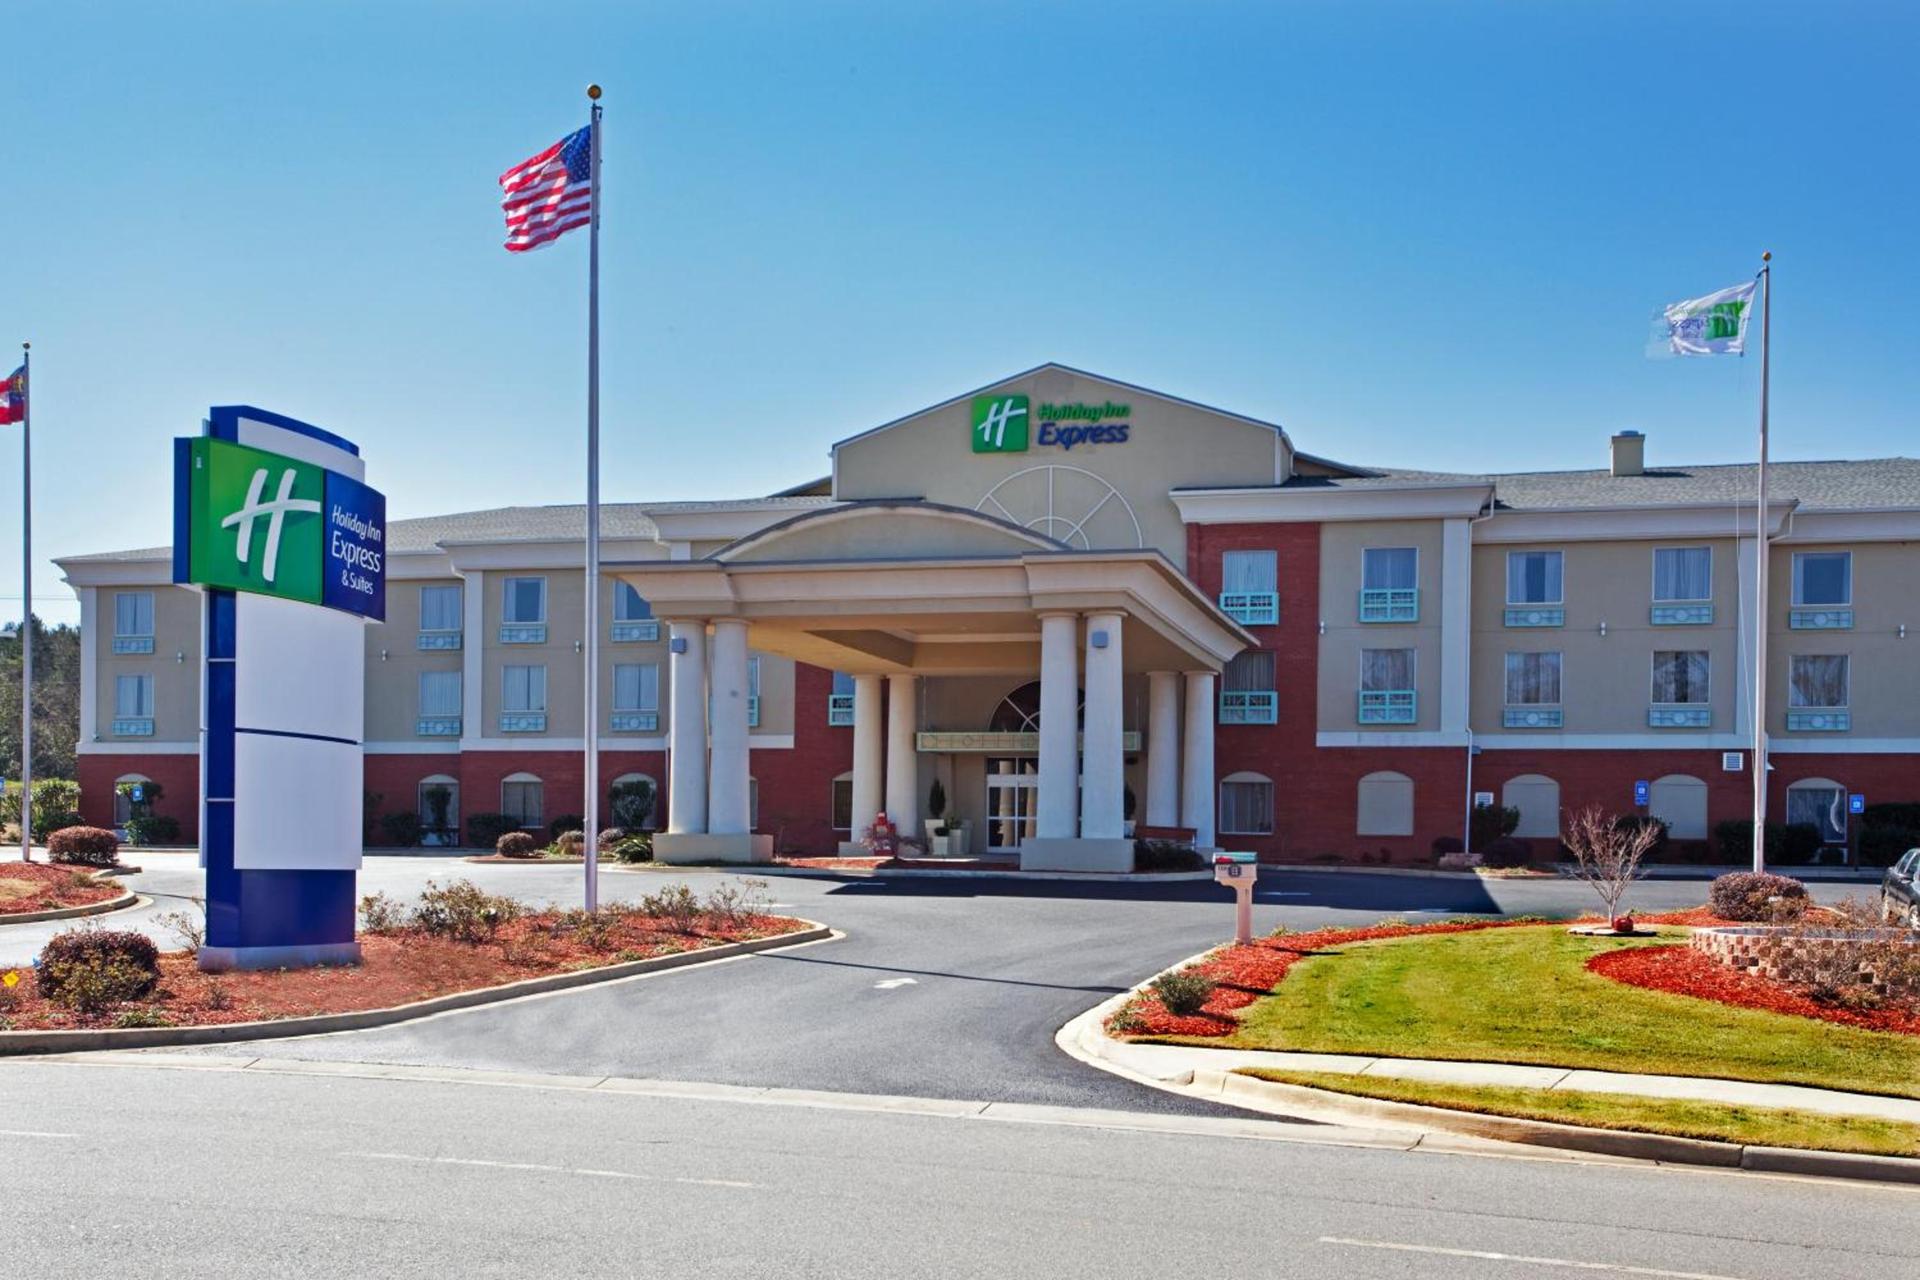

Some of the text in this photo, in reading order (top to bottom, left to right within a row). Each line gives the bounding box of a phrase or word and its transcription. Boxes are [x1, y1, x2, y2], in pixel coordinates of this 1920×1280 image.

[1038, 400, 1131, 422] Holiday Inn
[1038, 422, 1129, 450] Express
[332, 504, 382, 541] Holiday Inn
[332, 530, 381, 573] Express
[341, 569, 374, 595] & Suites
